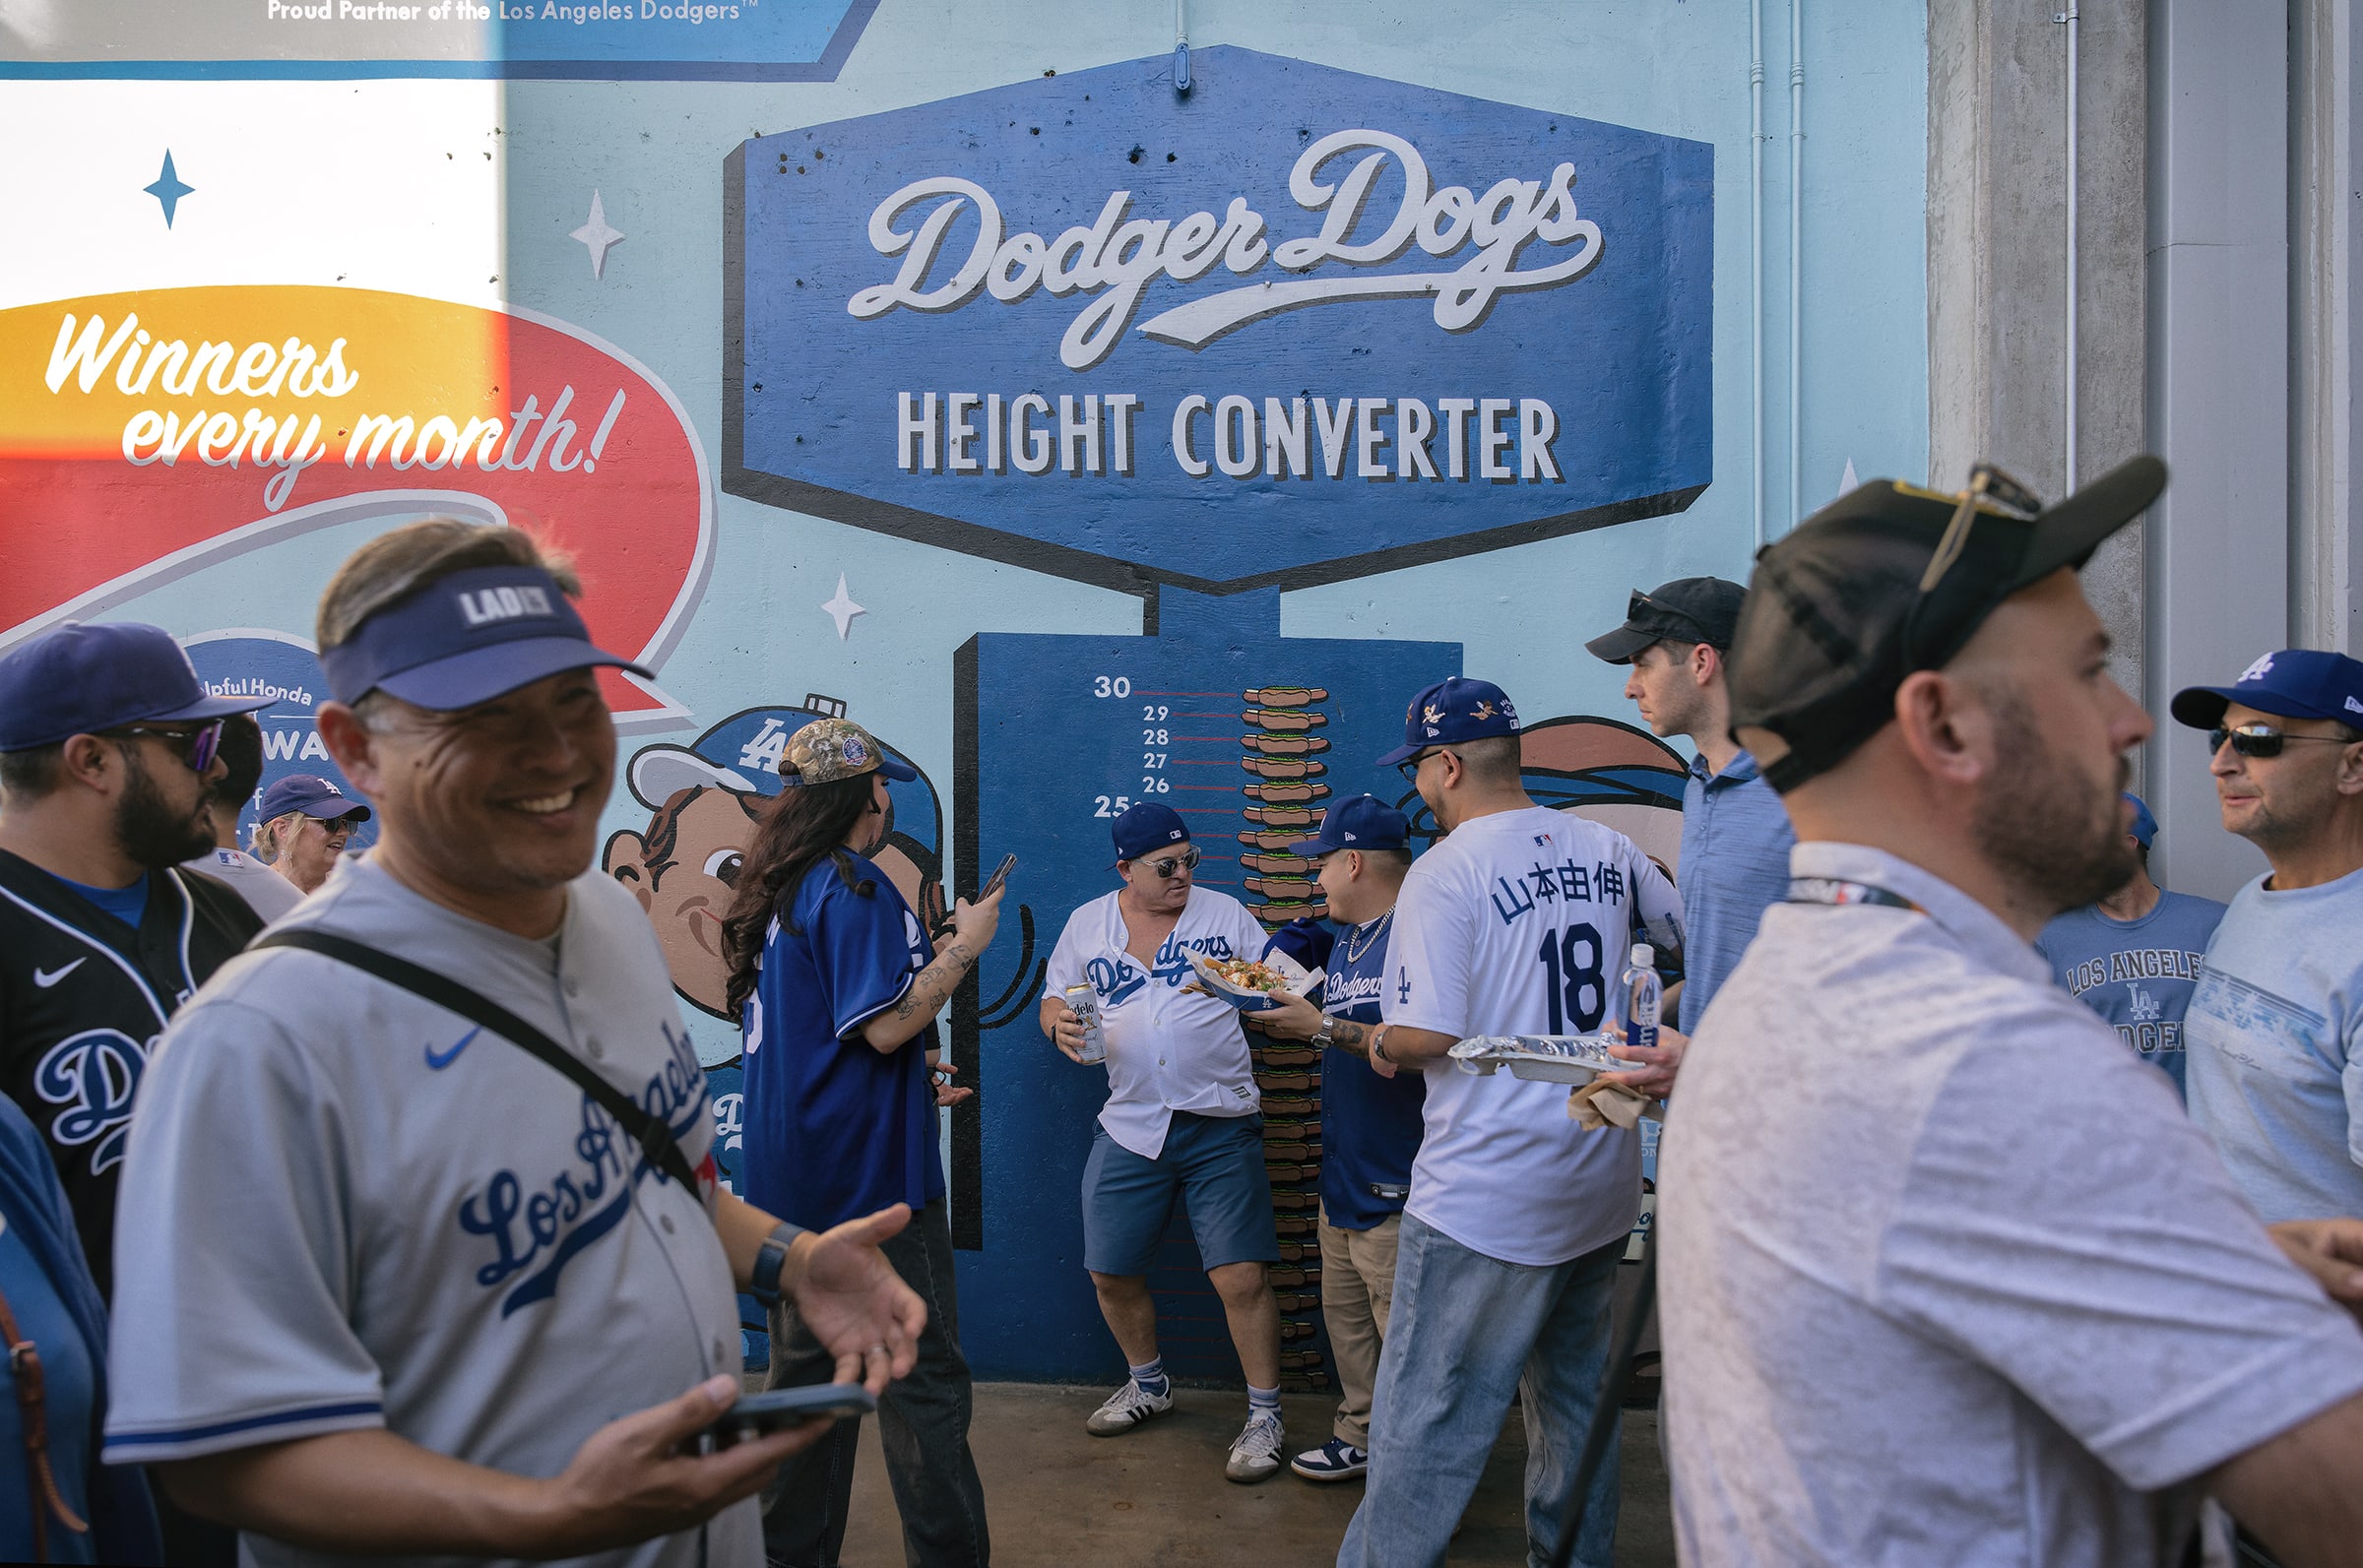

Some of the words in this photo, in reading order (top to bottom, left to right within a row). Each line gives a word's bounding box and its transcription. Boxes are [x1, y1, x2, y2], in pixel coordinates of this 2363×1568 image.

[268, 0, 332, 20] Proud
[340, 0, 421, 20] Partner
[428, 0, 452, 20] of
[456, 1, 490, 20] the
[499, 1, 535, 20] Los
[541, 0, 633, 25] Angeles
[848, 176, 1269, 370] Dodger
[1274, 129, 1604, 332] Dogs
[44, 311, 358, 396] Winners
[121, 408, 326, 512] every
[345, 388, 626, 474] month!
[897, 391, 1142, 476] HEIGHT
[1173, 395, 1565, 485] CONVERTER
[200, 677, 246, 696] lpful
[250, 677, 313, 706] Honda
[1094, 675, 1130, 698] 30
[1142, 705, 1169, 721] 29
[738, 718, 787, 774] LA
[1142, 728, 1169, 745] 28
[1143, 752, 1168, 769] 27
[1142, 776, 1170, 793] 26
[1094, 794, 1129, 818] 25
[1490, 857, 1626, 926] 山本由伸
[1539, 921, 1607, 1035] 18
[2067, 957, 2107, 999] LOS
[1066, 1002, 1095, 1016] delo
[2127, 983, 2160, 1021] LA
[1638, 1001, 1655, 1046] mart
[460, 1169, 581, 1286] Los
